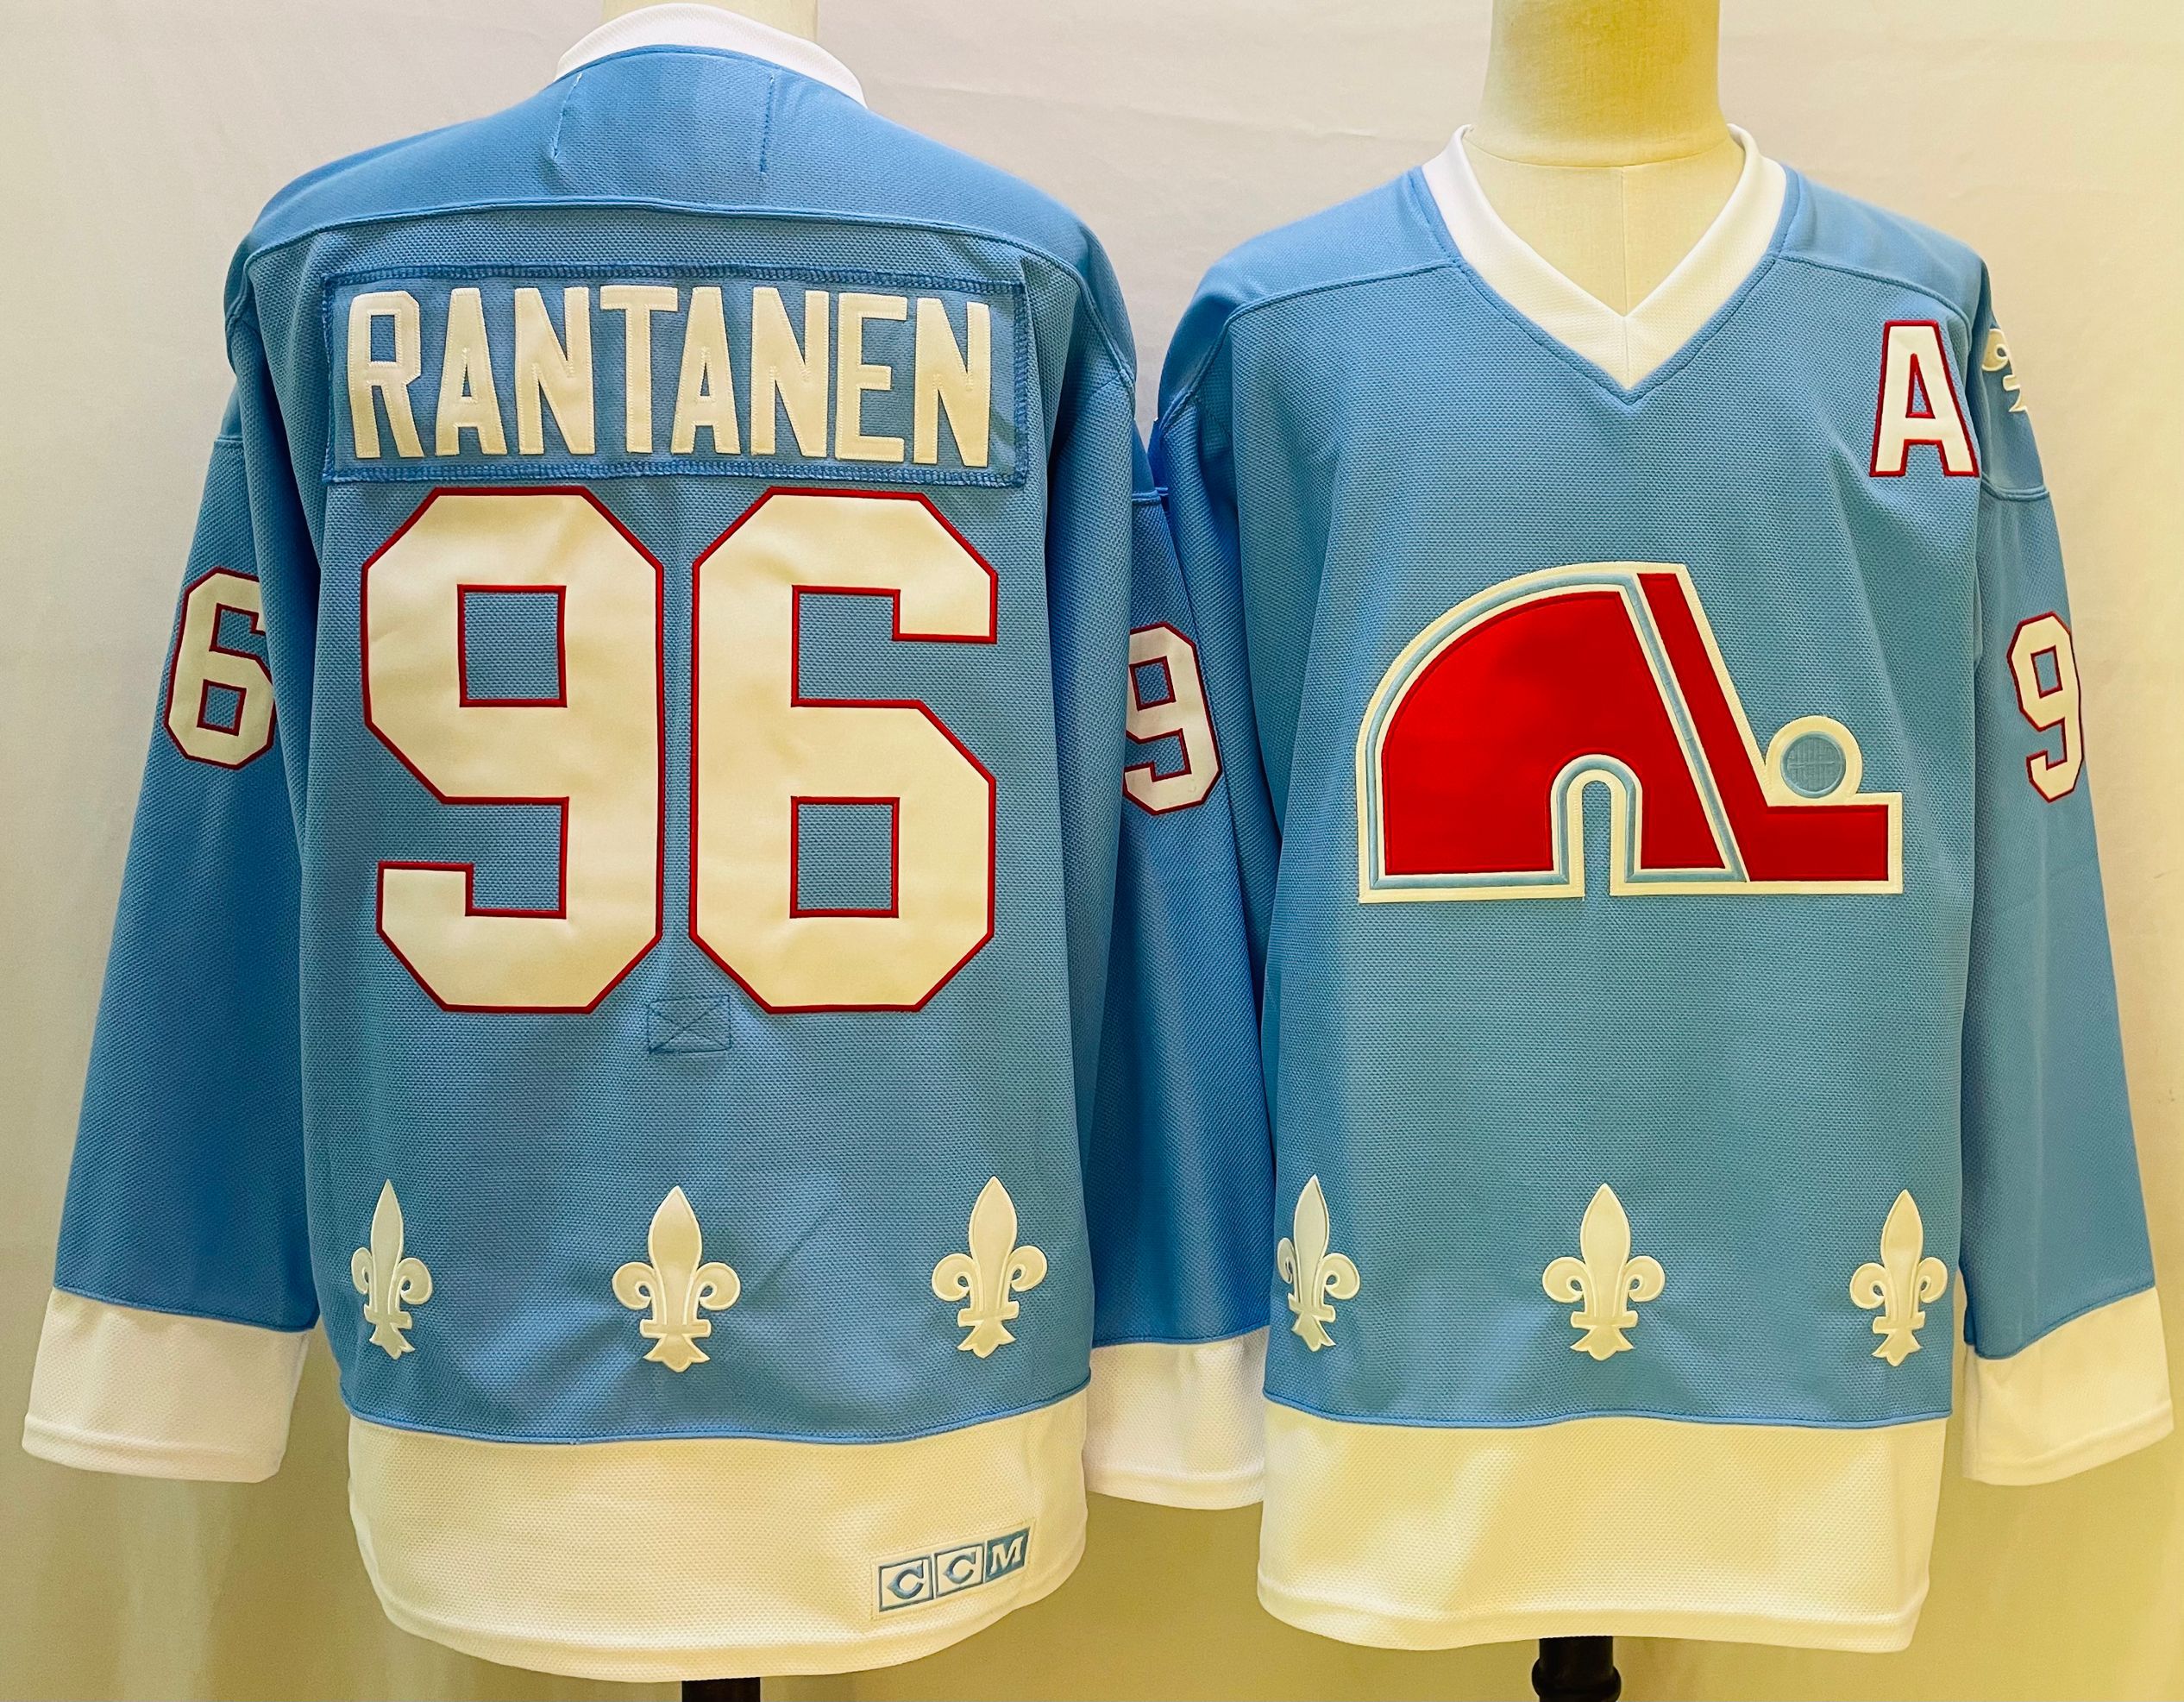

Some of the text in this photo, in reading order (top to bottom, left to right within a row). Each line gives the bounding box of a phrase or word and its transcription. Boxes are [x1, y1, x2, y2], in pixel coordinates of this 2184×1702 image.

[345, 284, 990, 468] RANTANEN
[1869, 319, 1980, 477] A
[162, 566, 277, 770] 6
[361, 487, 998, 1014] 96
[1122, 621, 1223, 816] 9
[2006, 611, 2085, 803] 9
[886, 1535, 1024, 1599] CCM
